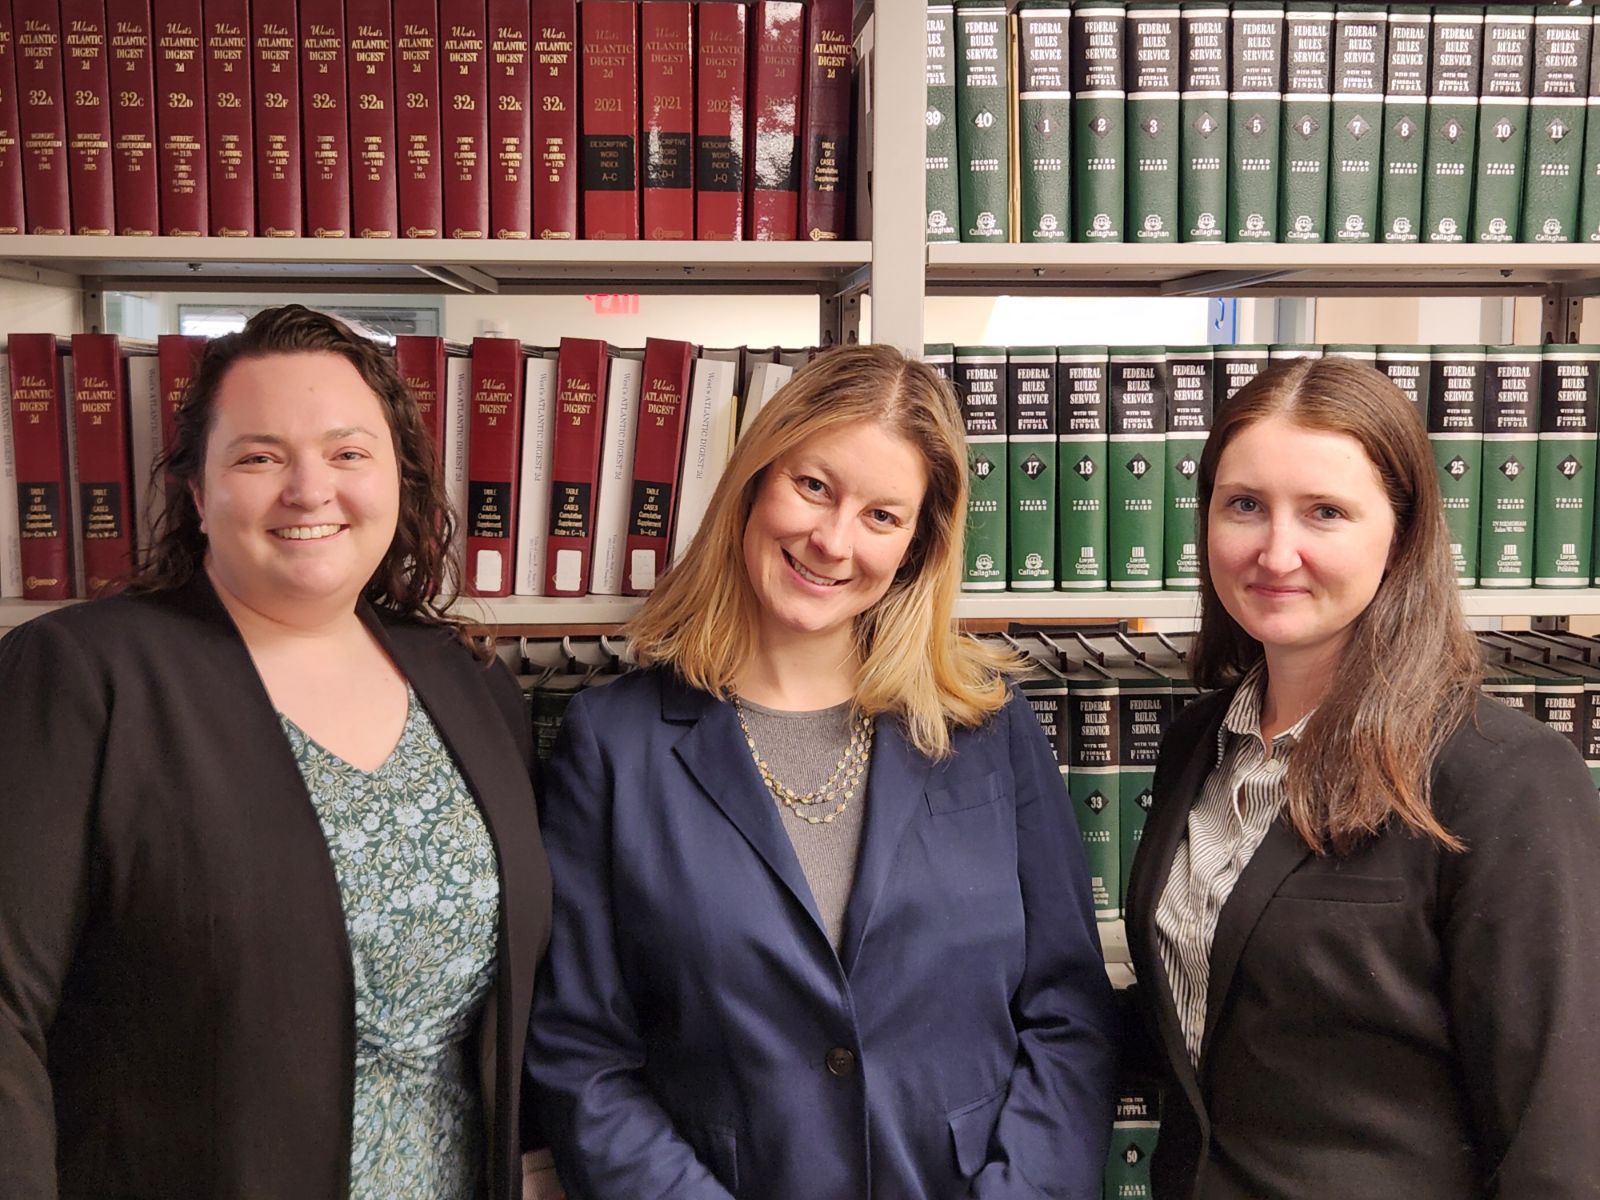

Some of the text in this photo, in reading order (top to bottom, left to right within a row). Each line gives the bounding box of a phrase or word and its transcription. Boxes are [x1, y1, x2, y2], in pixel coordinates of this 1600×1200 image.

[965, 22, 998, 34] FEDERAL
[1030, 23, 1062, 34] FEDERAL
[1085, 22, 1118, 33] FEDERAL
[1138, 23, 1171, 35] FEDERAL
[1190, 22, 1222, 34] FEDERAL
[1243, 24, 1275, 35] FEDERAL
[1294, 26, 1327, 36] FEDERAL
[1345, 26, 1377, 37] FEDERAL
[1393, 28, 1425, 38] FEDERAL
[1441, 29, 1474, 39] FEDERAL
[1493, 29, 1526, 39] FEDERAL
[1547, 29, 1580, 40] FEDERAL
[19, 35, 57, 44] ATLANTIC
[67, 35, 103, 45] ATLANTIC
[112, 36, 147, 46] ATLANTIC
[160, 37, 199, 47] ATLANTIC
[210, 37, 246, 47] ATLANTIC
[257, 38, 294, 48] ATLANTIC
[305, 39, 341, 49] ATLANTIC
[352, 40, 389, 49] ATLANTIC
[399, 39, 434, 48] ATLANTIC
[970, 35, 994, 46] RULES
[1035, 36, 1058, 47] RULES
[1090, 35, 1113, 46] RULES
[1143, 36, 1166, 47] RULES
[1195, 35, 1218, 47] RULES
[1248, 37, 1270, 47] RULES
[1299, 39, 1321, 49] RULES
[1349, 39, 1372, 50] RULES
[445, 41, 483, 50] ATLANTIC
[493, 41, 527, 51] ATLANTIC
[535, 42, 572, 51] ATLANTIC
[584, 45, 632, 53] ATLANTIC
[813, 45, 850, 53] ATLANTIC
[1397, 41, 1420, 52] RULES
[1445, 41, 1468, 52] RULES
[1497, 42, 1521, 52] RULES
[1551, 43, 1574, 53] RULES
[25, 48, 52, 57] DIGEST
[72, 48, 98, 57] DIGEST
[117, 49, 143, 58] DIGEST
[165, 51, 194, 60] DIGEST
[214, 50, 241, 59] DIGEST
[262, 51, 289, 60] DIGEST
[310, 52, 337, 60] DIGEST
[357, 53, 385, 62] DIGEST
[403, 51, 430, 60] DIGEST
[450, 53, 478, 62] DIGEST
[966, 48, 998, 60] SERVICE
[1030, 49, 1062, 60] SERVICE
[1085, 48, 1117, 59] SERVICE
[1138, 49, 1170, 60] SERVICE
[1190, 49, 1221, 60] SERVICE
[1243, 50, 1274, 61] SERVICE
[1294, 52, 1325, 63] SERVICE
[1344, 52, 1374, 63] SERVICE
[496, 54, 523, 63] DIGEST
[540, 54, 567, 64] DIGEST
[590, 56, 626, 66] DIGEST
[651, 53, 683, 63] DIGEST
[818, 57, 845, 66] DIGEST
[1392, 54, 1423, 65] SERVICE
[1440, 55, 1471, 65] SERVICE
[1492, 55, 1523, 66] SERVICE
[1545, 56, 1577, 66] SERVICE
[654, 96, 681, 109] 2021
[975, 112, 992, 127] 40
[1043, 120, 1050, 132] 1
[1097, 119, 1106, 131] 2
[1150, 120, 1157, 132] 3
[1202, 119, 1211, 132] 4
[1253, 120, 1261, 132] 5
[1303, 121, 1311, 134] 6
[1353, 122, 1361, 134] 7
[1401, 123, 1408, 136] 8
[1449, 125, 1457, 137] 9
[1496, 125, 1510, 138] 10
[1551, 126, 1563, 138] 11
[1033, 230, 1064, 238] Callaghan
[1239, 229, 1270, 237] Callaghan
[966, 369, 998, 380] FEDERAL
[1018, 369, 1049, 379] FEDERAL
[1070, 368, 1101, 378] FEDERAL
[1123, 368, 1154, 378] FEDERAL
[1173, 365, 1205, 376] FEDERAL
[1226, 364, 1258, 375] FEDERAL
[1443, 366, 1475, 377] FEDERAL
[1497, 367, 1531, 377] FEDERAL
[1558, 366, 1589, 376] FEDERAL
[971, 382, 993, 392] RULES
[1023, 381, 1045, 391] RULES
[1074, 381, 1097, 391] RULES
[1127, 381, 1150, 391] RULES
[1177, 378, 1200, 388] RULES
[1448, 379, 1471, 389] RULES
[1502, 379, 1526, 390] RULES
[1562, 378, 1584, 388] RULES
[14, 390, 54, 399] ATLANTIC
[77, 391, 116, 400] ATLANTIC
[475, 393, 512, 402] ATLANTIC
[560, 392, 596, 402] ATLANTIC
[645, 393, 680, 403] ATLANTIC
[967, 394, 997, 405] SERVICE
[1018, 394, 1048, 404] SERVICE
[1070, 394, 1100, 404] SERVICE
[1123, 393, 1153, 404] SERVICE
[1174, 390, 1203, 400] SERVICE
[1444, 391, 1474, 401] SERVICE
[1498, 392, 1528, 402] SERVICE
[1558, 391, 1586, 401] SERVICE
[20, 402, 48, 412] DIGEST
[82, 403, 111, 412] DIGEST
[479, 405, 506, 414] DIGEST
[564, 405, 590, 414] DIGEST
[648, 405, 675, 415] DIGEST
[977, 462, 989, 475] 16
[1027, 462, 1039, 474] 17
[1080, 461, 1092, 474] 18
[1133, 461, 1145, 474] 19
[1183, 461, 1195, 474] 20
[1451, 461, 1464, 474] 25
[1505, 462, 1518, 475] 26
[1564, 462, 1576, 474] 27
[1080, 701, 1110, 711] FEDERAL
[1130, 700, 1161, 710] FEDERAL
[1545, 698, 1576, 708] FEDERAL
[1085, 713, 1107, 724] RULES
[1135, 711, 1157, 722] RULES
[1549, 710, 1571, 720] RULES
[1081, 725, 1110, 735] SERVICE
[1132, 724, 1160, 734] SERVICE
[1091, 796, 1102, 808] 33
